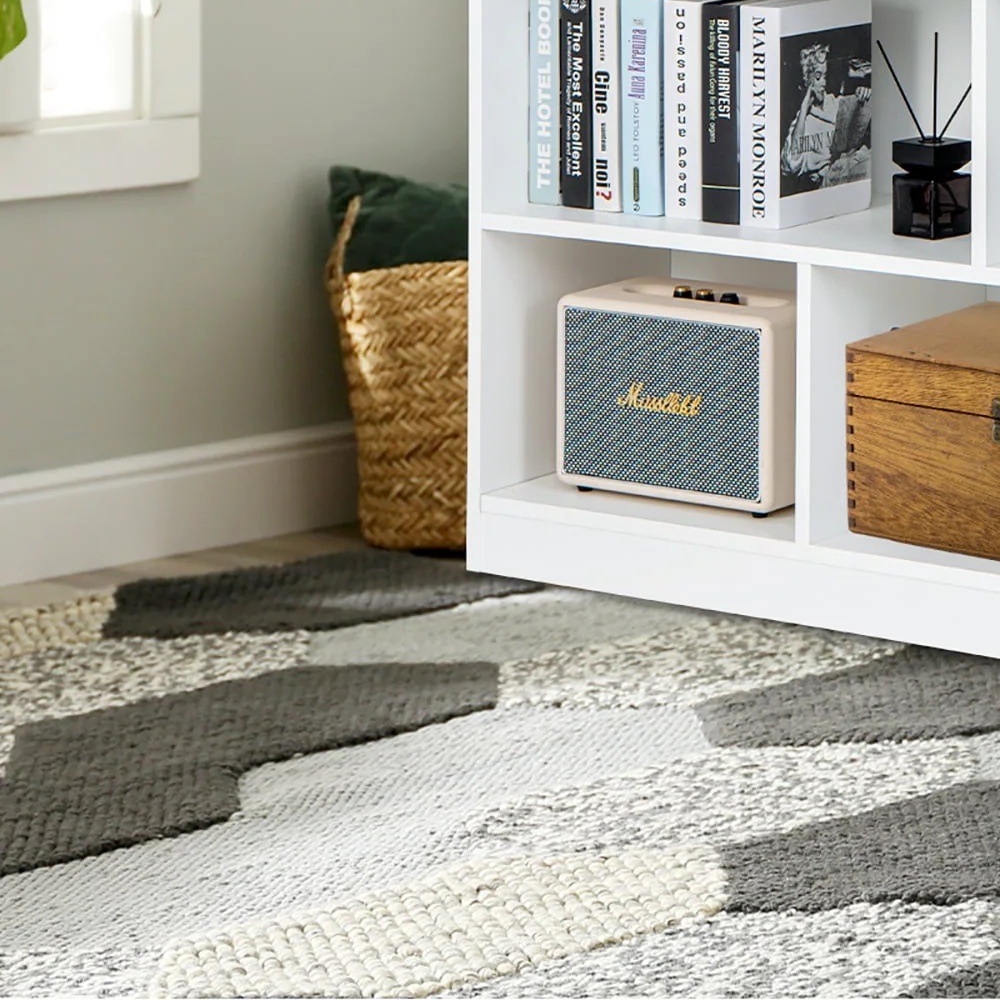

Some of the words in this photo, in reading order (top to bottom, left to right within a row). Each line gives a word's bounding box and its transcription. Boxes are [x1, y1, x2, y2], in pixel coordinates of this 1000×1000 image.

[572, 21, 584, 52] The
[627, 28, 647, 73] Karenina
[675, 7, 687, 95] passion
[716, 18, 730, 65] BLOODY
[572, 57, 584, 98] Most
[627, 75, 646, 100] Anna
[751, 15, 766, 117] MARILYN
[536, 59, 552, 138] HOTEL
[594, 70, 610, 114] Cine
[717, 67, 731, 121] HARVEST
[571, 101, 583, 178] Excellent
[632, 101, 640, 142] TOLSTOY
[677, 103, 687, 138] and
[536, 143, 552, 190] THE
[632, 144, 640, 162] LEO
[751, 123, 766, 220] MONROE
[595, 158, 611, 201] noi?
[677, 146, 688, 208] speed
